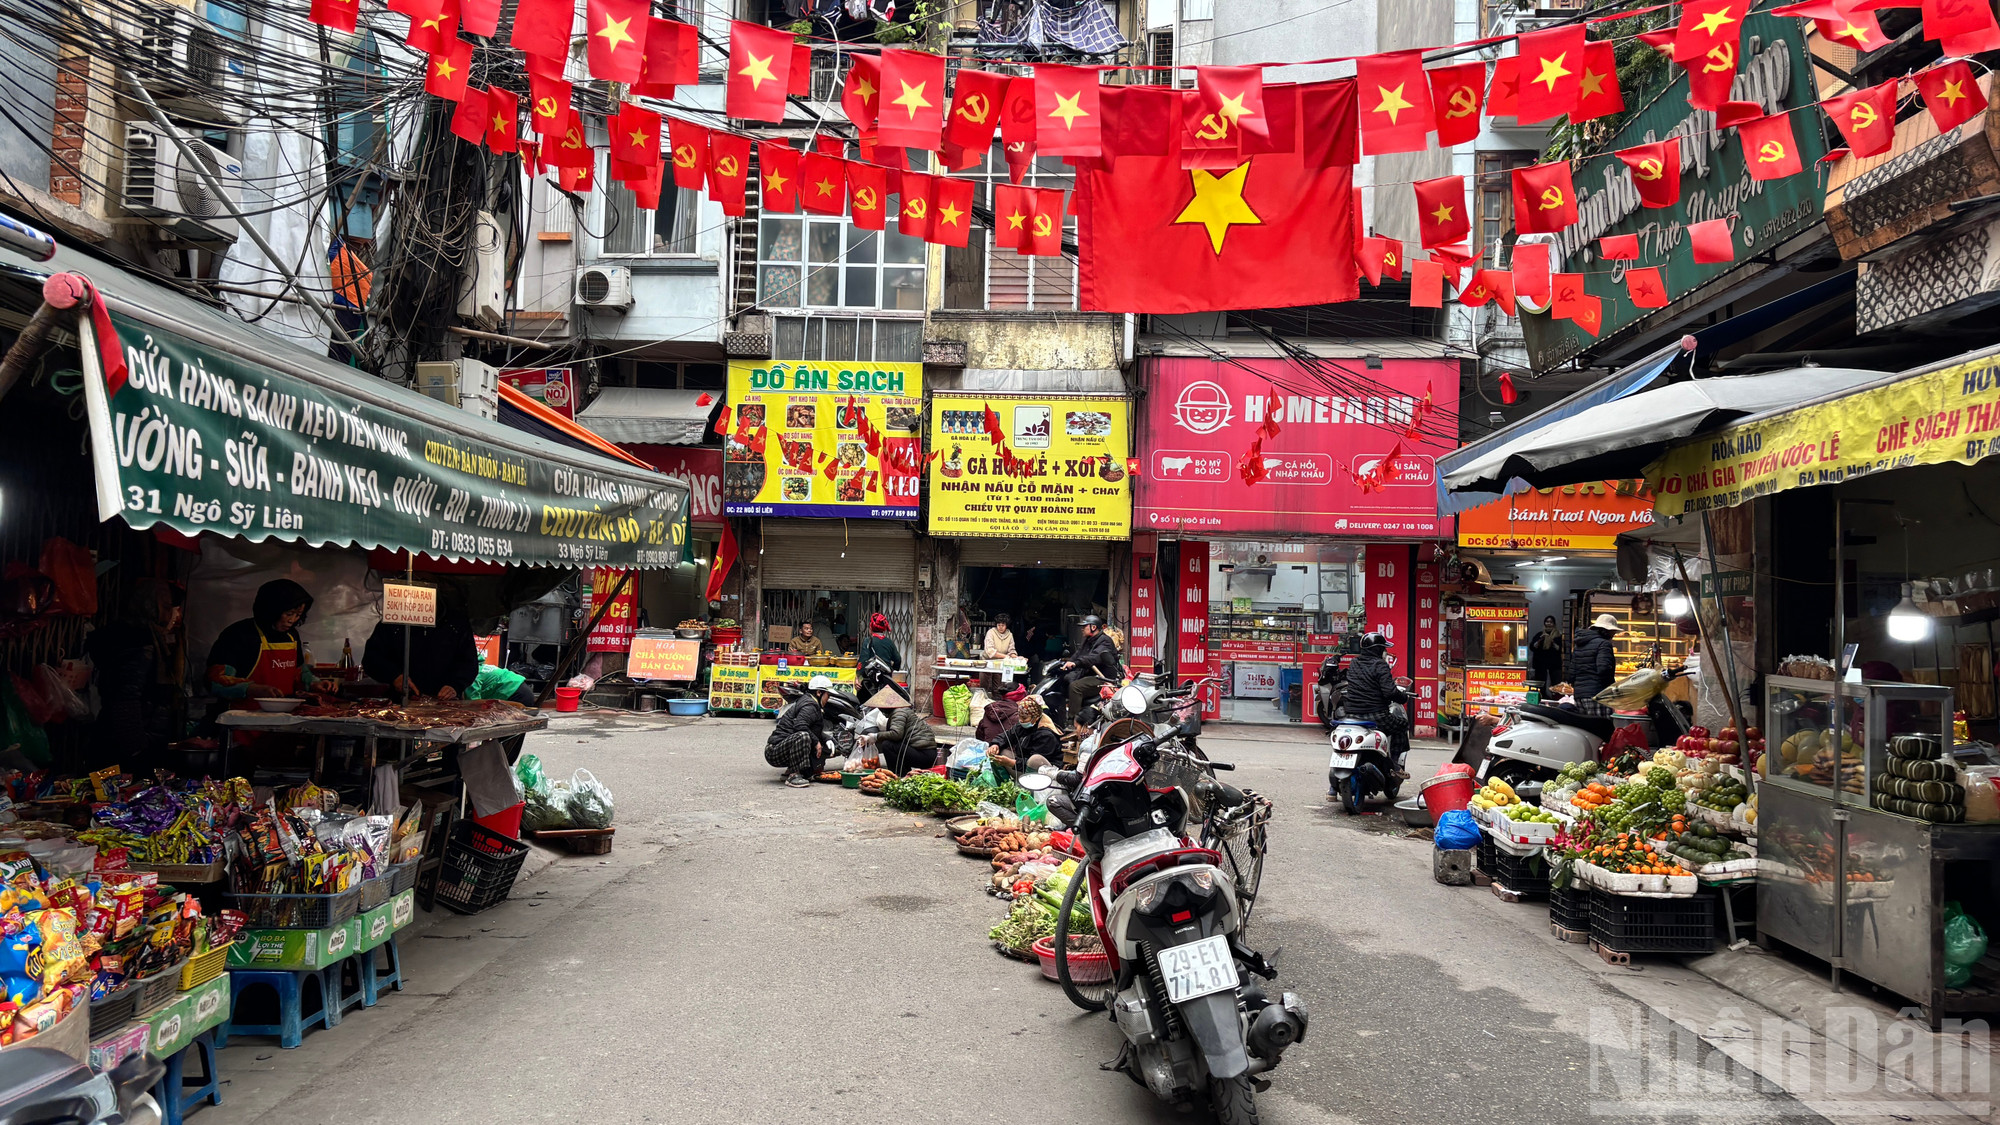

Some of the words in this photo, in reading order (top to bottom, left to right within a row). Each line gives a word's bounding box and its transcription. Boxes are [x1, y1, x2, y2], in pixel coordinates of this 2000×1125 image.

[749, 362, 786, 389] ĐỒ
[794, 365, 828, 390] ĂN
[127, 334, 173, 399] CỬA
[180, 357, 242, 418] HÀNG
[243, 379, 297, 430] BÁNH
[299, 398, 338, 444] KẸO
[338, 404, 376, 451] TIẾN
[1244, 394, 1414, 425] HOMEFARM
[1876, 416, 1910, 454] CHÈ
[1912, 407, 1961, 448] SẠCH
[1966, 438, 1986, 460] ĐT:
[115, 405, 203, 481] ƯỜNG
[224, 431, 272, 491] SỮA
[344, 464, 382, 515] KẸO
[392, 472, 439, 524] RƯỢU
[443, 488, 471, 524] BIA
[477, 489, 518, 531] THUỐC
[461, 446, 478, 475] BÁN
[478, 452, 499, 479] BUÔN
[502, 457, 517, 484] BÁN
[967, 453, 988, 475] GÀ
[1194, 458, 1207, 468] BÒ
[1208, 457, 1222, 468] MỸ
[1284, 459, 1298, 470] CÁ
[1299, 458, 1316, 470] HỒI
[1687, 465, 1709, 494] CHẢ
[1712, 465, 1736, 489] GIA
[1818, 430, 1841, 462] LỄ
[1194, 466, 1207, 476] BÒ
[1208, 465, 1222, 476] ÚC
[1275, 469, 1299, 480] NHẬP
[1300, 468, 1325, 479] KHẨU
[1404, 470, 1429, 481] KHẨU
[1798, 471, 1815, 487] 64
[554, 464, 580, 497] CỬA
[583, 472, 619, 503] HÀNG
[941, 481, 981, 494] NHẬN
[984, 480, 1014, 493] NẤU
[1017, 481, 1037, 493] CỖ
[1041, 484, 1074, 496] MẶN
[1092, 487, 1120, 496] CHAY
[127, 485, 162, 514] 31
[174, 493, 222, 523] Ngô
[229, 501, 255, 529] Sỹ
[263, 506, 303, 530] Liên
[995, 505, 1011, 514] VỊT
[1013, 505, 1038, 515] QUAY
[1040, 506, 1074, 514] HOÀNG
[1077, 507, 1096, 515] KIM
[1160, 515, 1171, 523] SỐ
[1182, 516, 1198, 524] NGÔ
[1206, 517, 1221, 525] LIÊN
[1508, 508, 1549, 522] Bánh
[1552, 508, 1584, 522] Tươi
[1587, 509, 1625, 524] Ngon
[431, 528, 449, 551] ĐT:
[451, 532, 476, 554] 0833
[477, 536, 495, 556] 055
[497, 539, 513, 557] 634
[1468, 537, 1484, 546] ĐC:
[1485, 534, 1499, 546] SỐ
[1535, 536, 1547, 547] SỸ
[1549, 537, 1570, 547] LIÊN
[558, 543, 568, 558] 33
[570, 544, 584, 561] Ngô
[585, 545, 594, 562] Sỹ
[595, 546, 608, 560] Liên
[1189, 557, 1201, 573] CÁ
[1377, 560, 1395, 578] BÒ
[1138, 587, 1149, 598] CÁ
[1186, 584, 1202, 603] HỒI
[1376, 591, 1395, 608] MỸ
[1136, 604, 1150, 617] HỒI
[1421, 598, 1432, 609] BÒ
[1470, 608, 1496, 618] DONER
[1497, 609, 1523, 618] KEBAB
[1182, 616, 1205, 636] NHẬP
[1420, 617, 1433, 629] MỸ
[1132, 625, 1152, 638] NHẬP
[1420, 637, 1432, 649] BÒ
[635, 650, 655, 659] CHẢ
[658, 651, 692, 661] NƯỚNG
[1181, 644, 1205, 663] KHẨU
[1420, 656, 1432, 669] ÚC
[1470, 671, 1486, 679] TAM
[1487, 671, 1505, 680] GIÁC
[1507, 672, 1521, 680] 25K
[1419, 685, 1432, 699] 18
[330, 936, 345, 948] MILO
[1168, 940, 1222, 975] 29-E1
[159, 1023, 179, 1042] MILO
